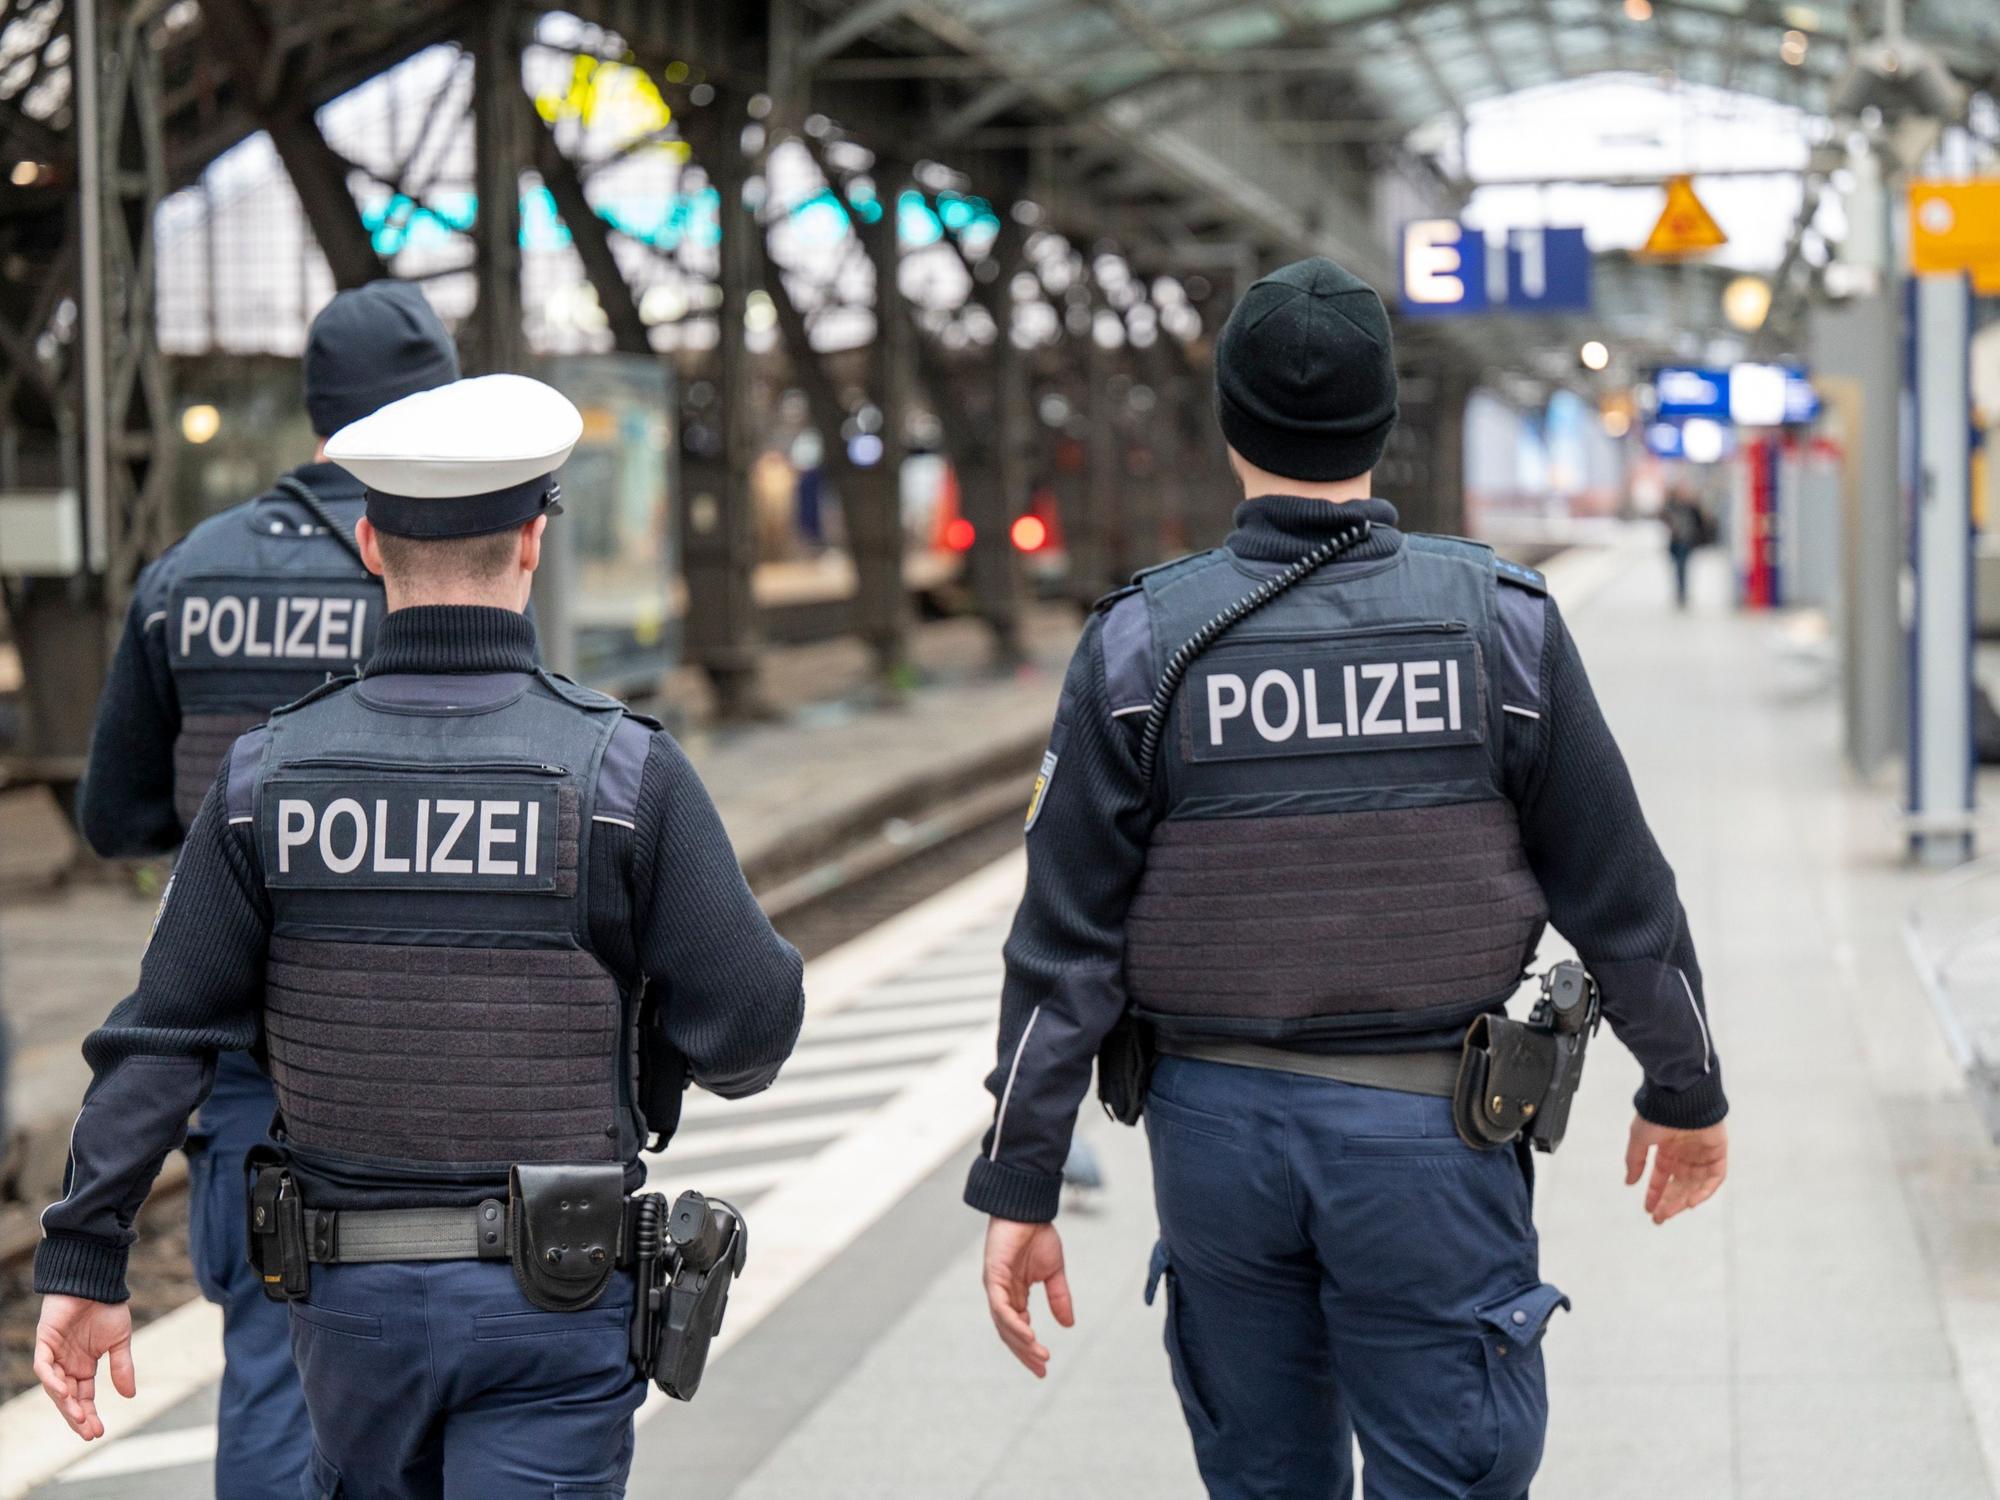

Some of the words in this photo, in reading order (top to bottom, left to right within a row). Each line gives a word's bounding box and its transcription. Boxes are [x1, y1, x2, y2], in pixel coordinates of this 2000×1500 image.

[1404, 219, 1464, 303] E
[180, 596, 367, 659] POLIZEI
[1207, 659, 1462, 746] POLIZEI
[278, 797, 540, 875] POLIZEI
